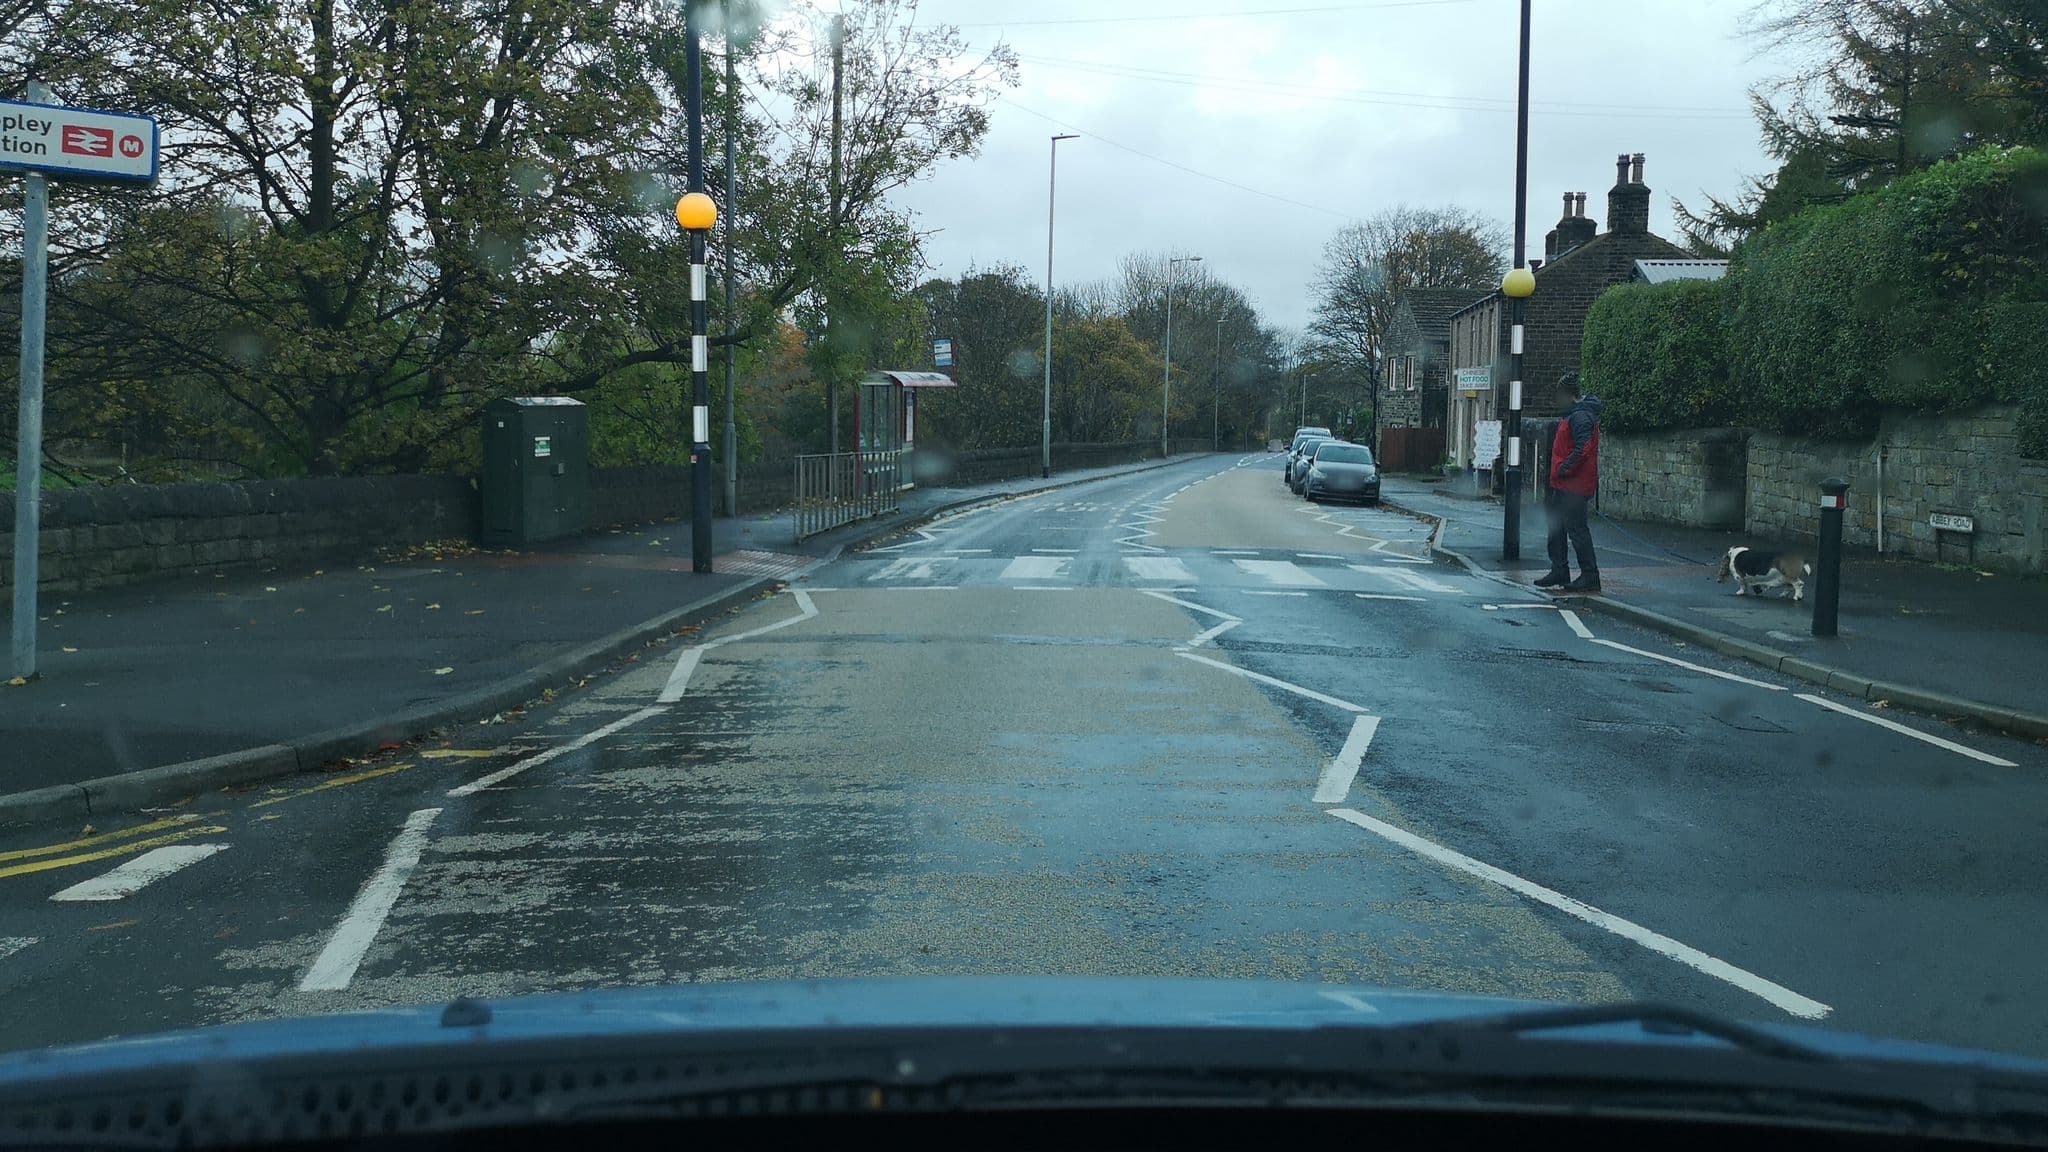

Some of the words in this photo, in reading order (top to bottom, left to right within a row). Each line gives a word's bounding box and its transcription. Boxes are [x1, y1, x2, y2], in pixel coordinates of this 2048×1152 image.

[0, 114, 52, 136] pley
[0, 135, 47, 156] tion
[1931, 513, 1950, 527] ABBEY
[1953, 516, 1970, 529] ROAD
